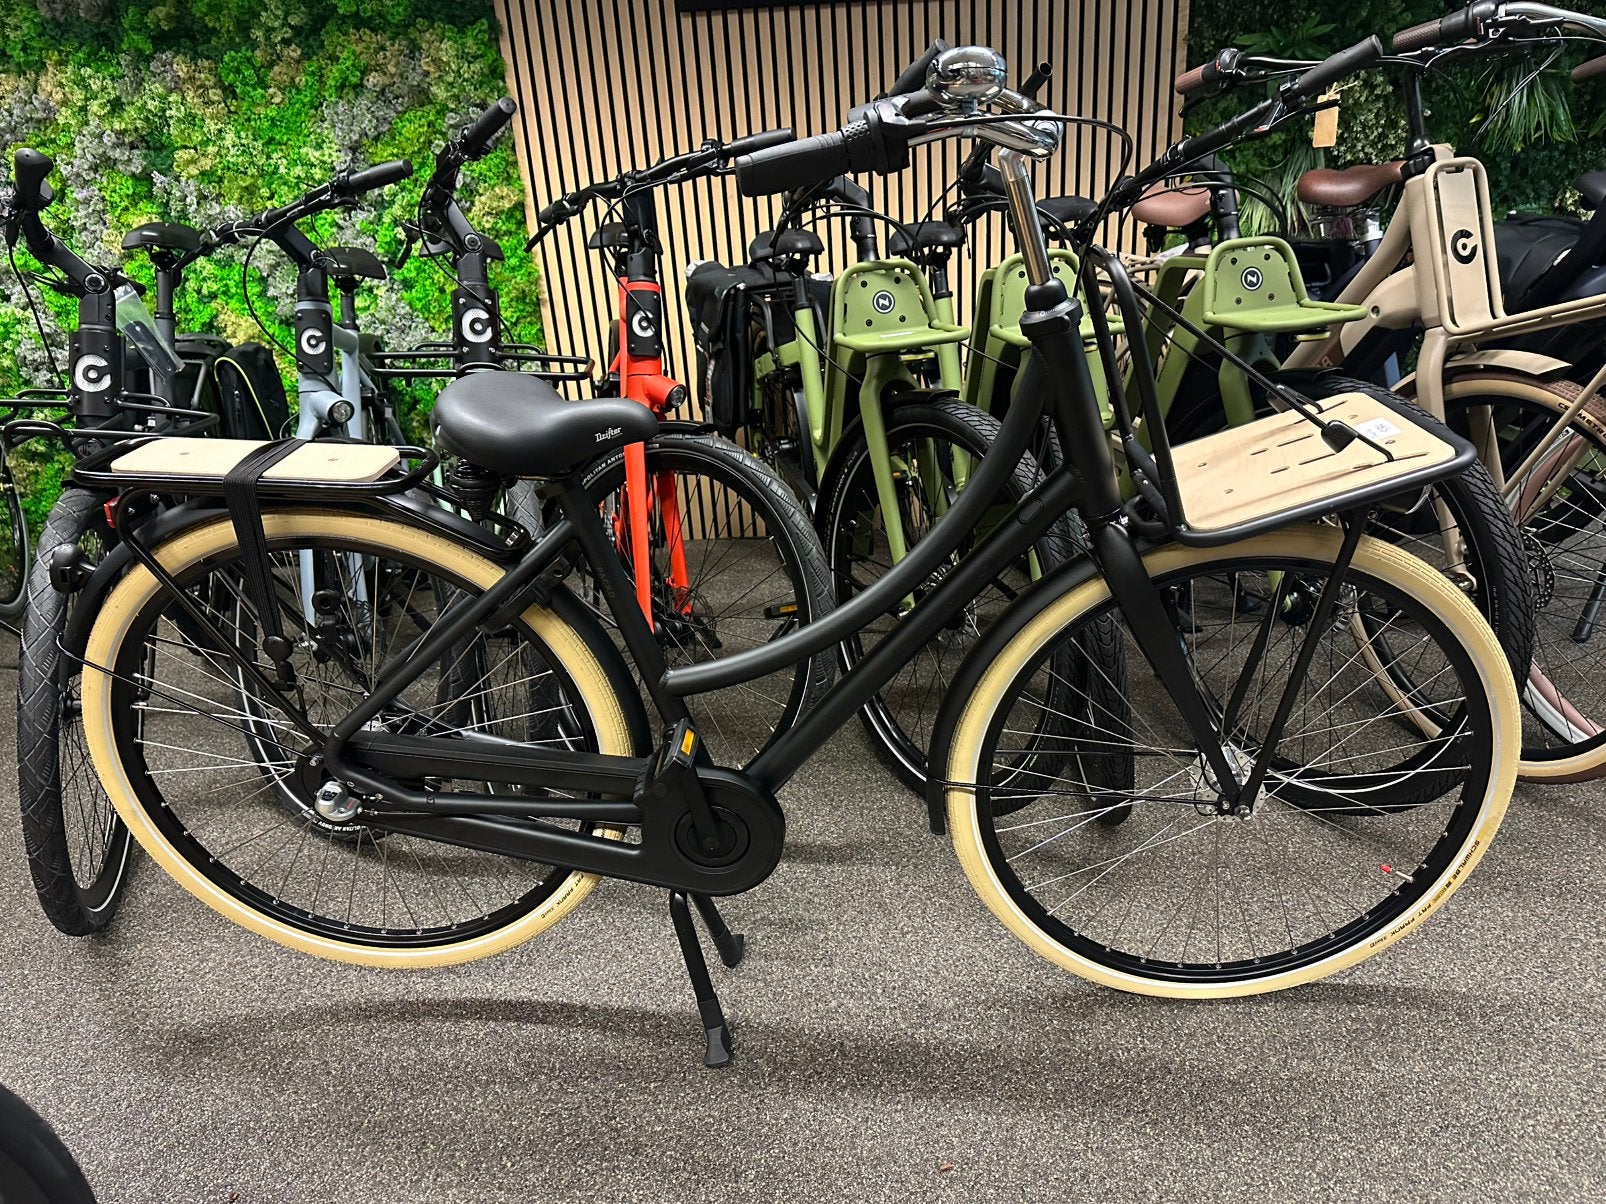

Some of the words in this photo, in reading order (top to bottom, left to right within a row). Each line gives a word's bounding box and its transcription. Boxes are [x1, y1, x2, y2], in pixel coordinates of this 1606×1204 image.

[1557, 402, 1570, 411] CS
[594, 427, 622, 443] Drifter
[1451, 839, 1481, 881] SCHWALBE
